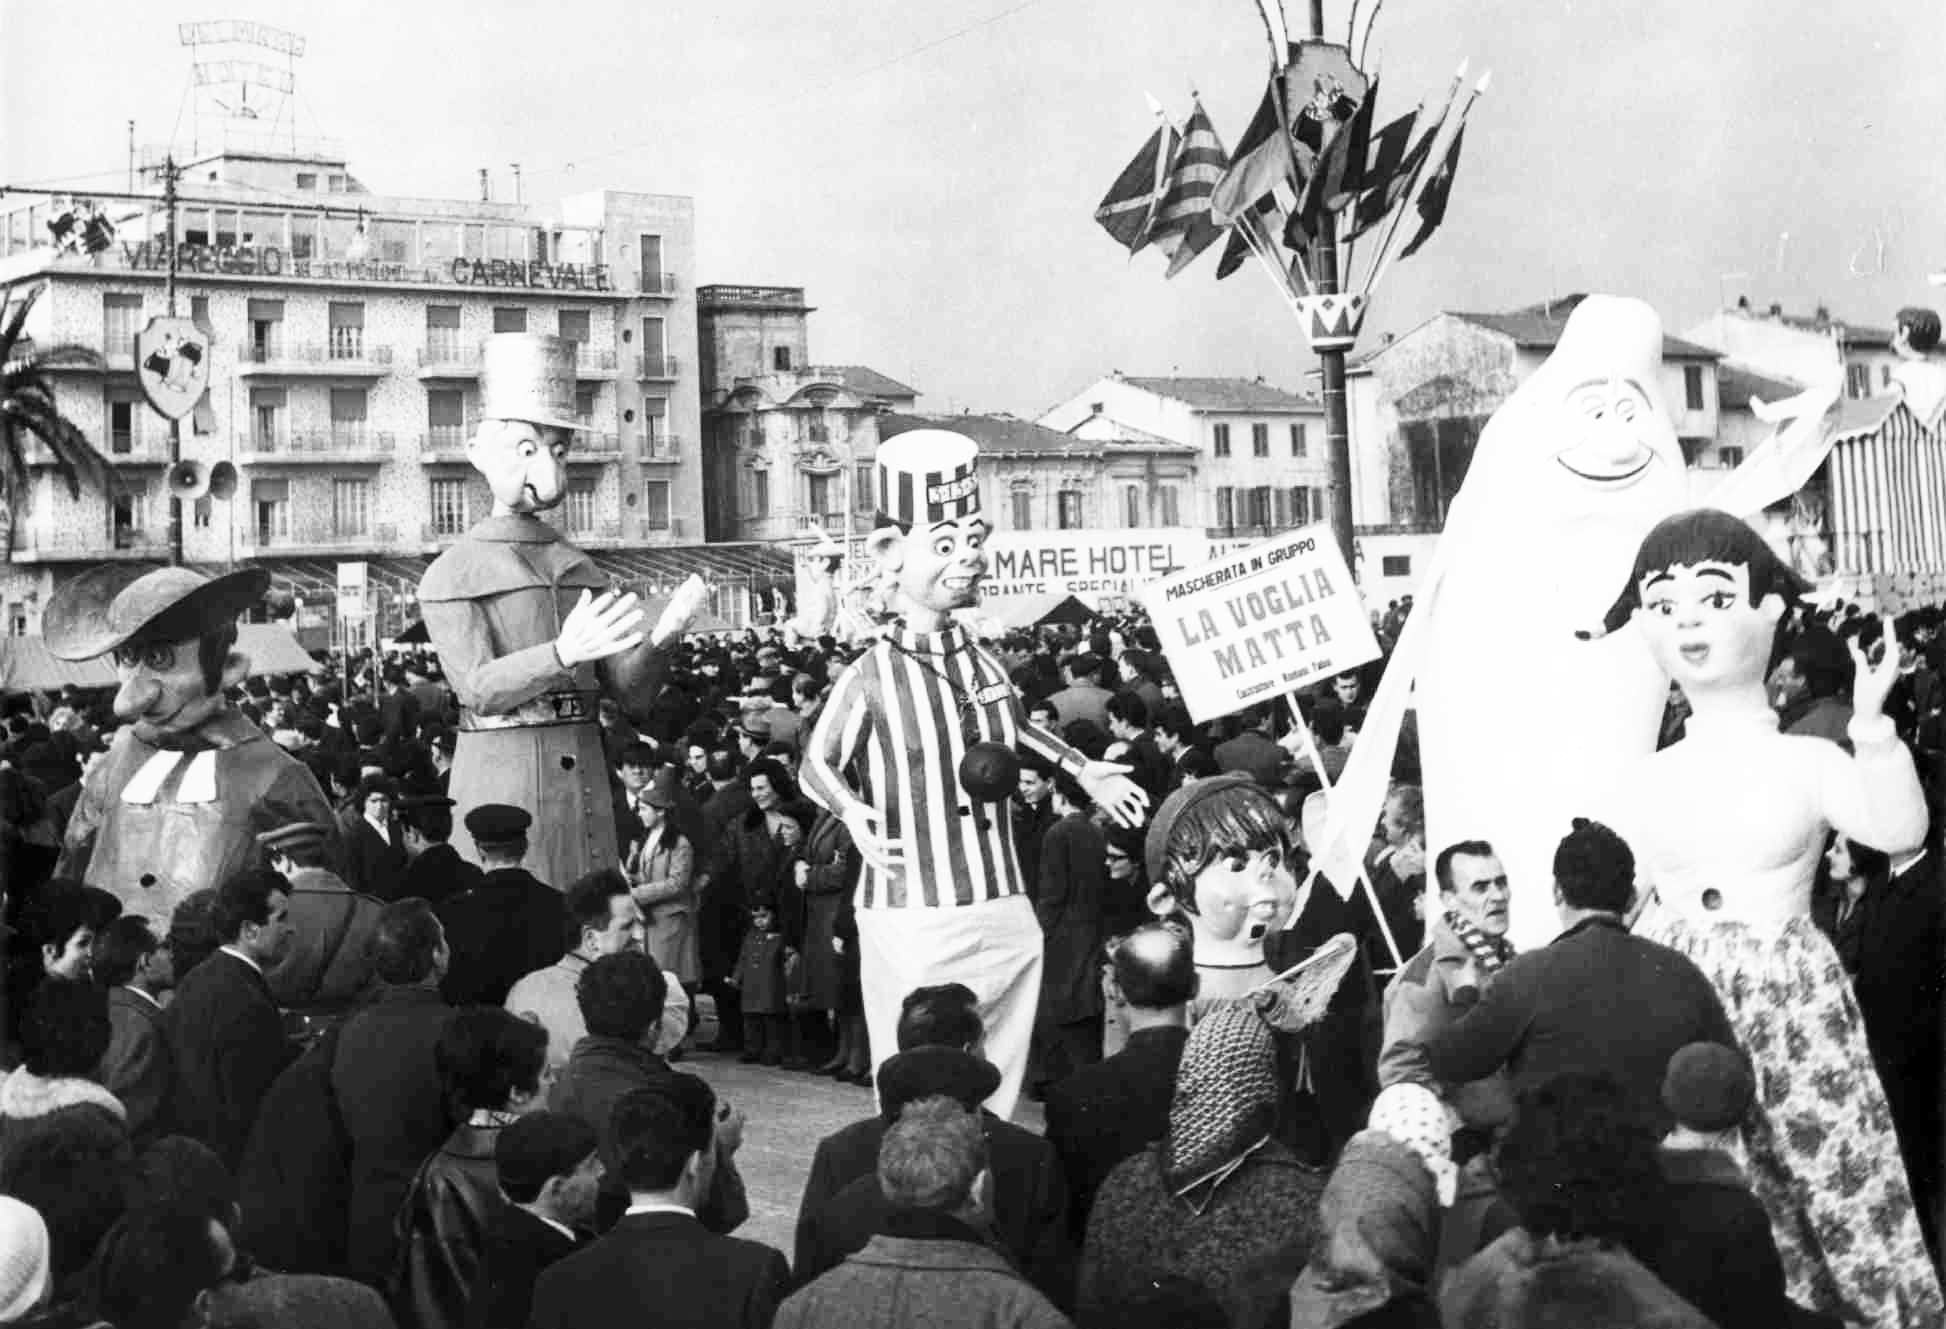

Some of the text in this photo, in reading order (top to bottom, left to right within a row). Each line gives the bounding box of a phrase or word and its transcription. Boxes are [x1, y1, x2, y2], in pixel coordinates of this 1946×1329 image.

[452, 257, 609, 292] CARNEVALE
[985, 547, 1079, 579] MARE
[1089, 544, 1185, 575] HOTEL
[1166, 562, 1247, 601] MASCHERATA
[1250, 555, 1263, 571] IN
[1268, 537, 1316, 566] GRUPPO
[1177, 567, 1336, 647] LA VOGLIA
[1213, 613, 1332, 679] MATTA
